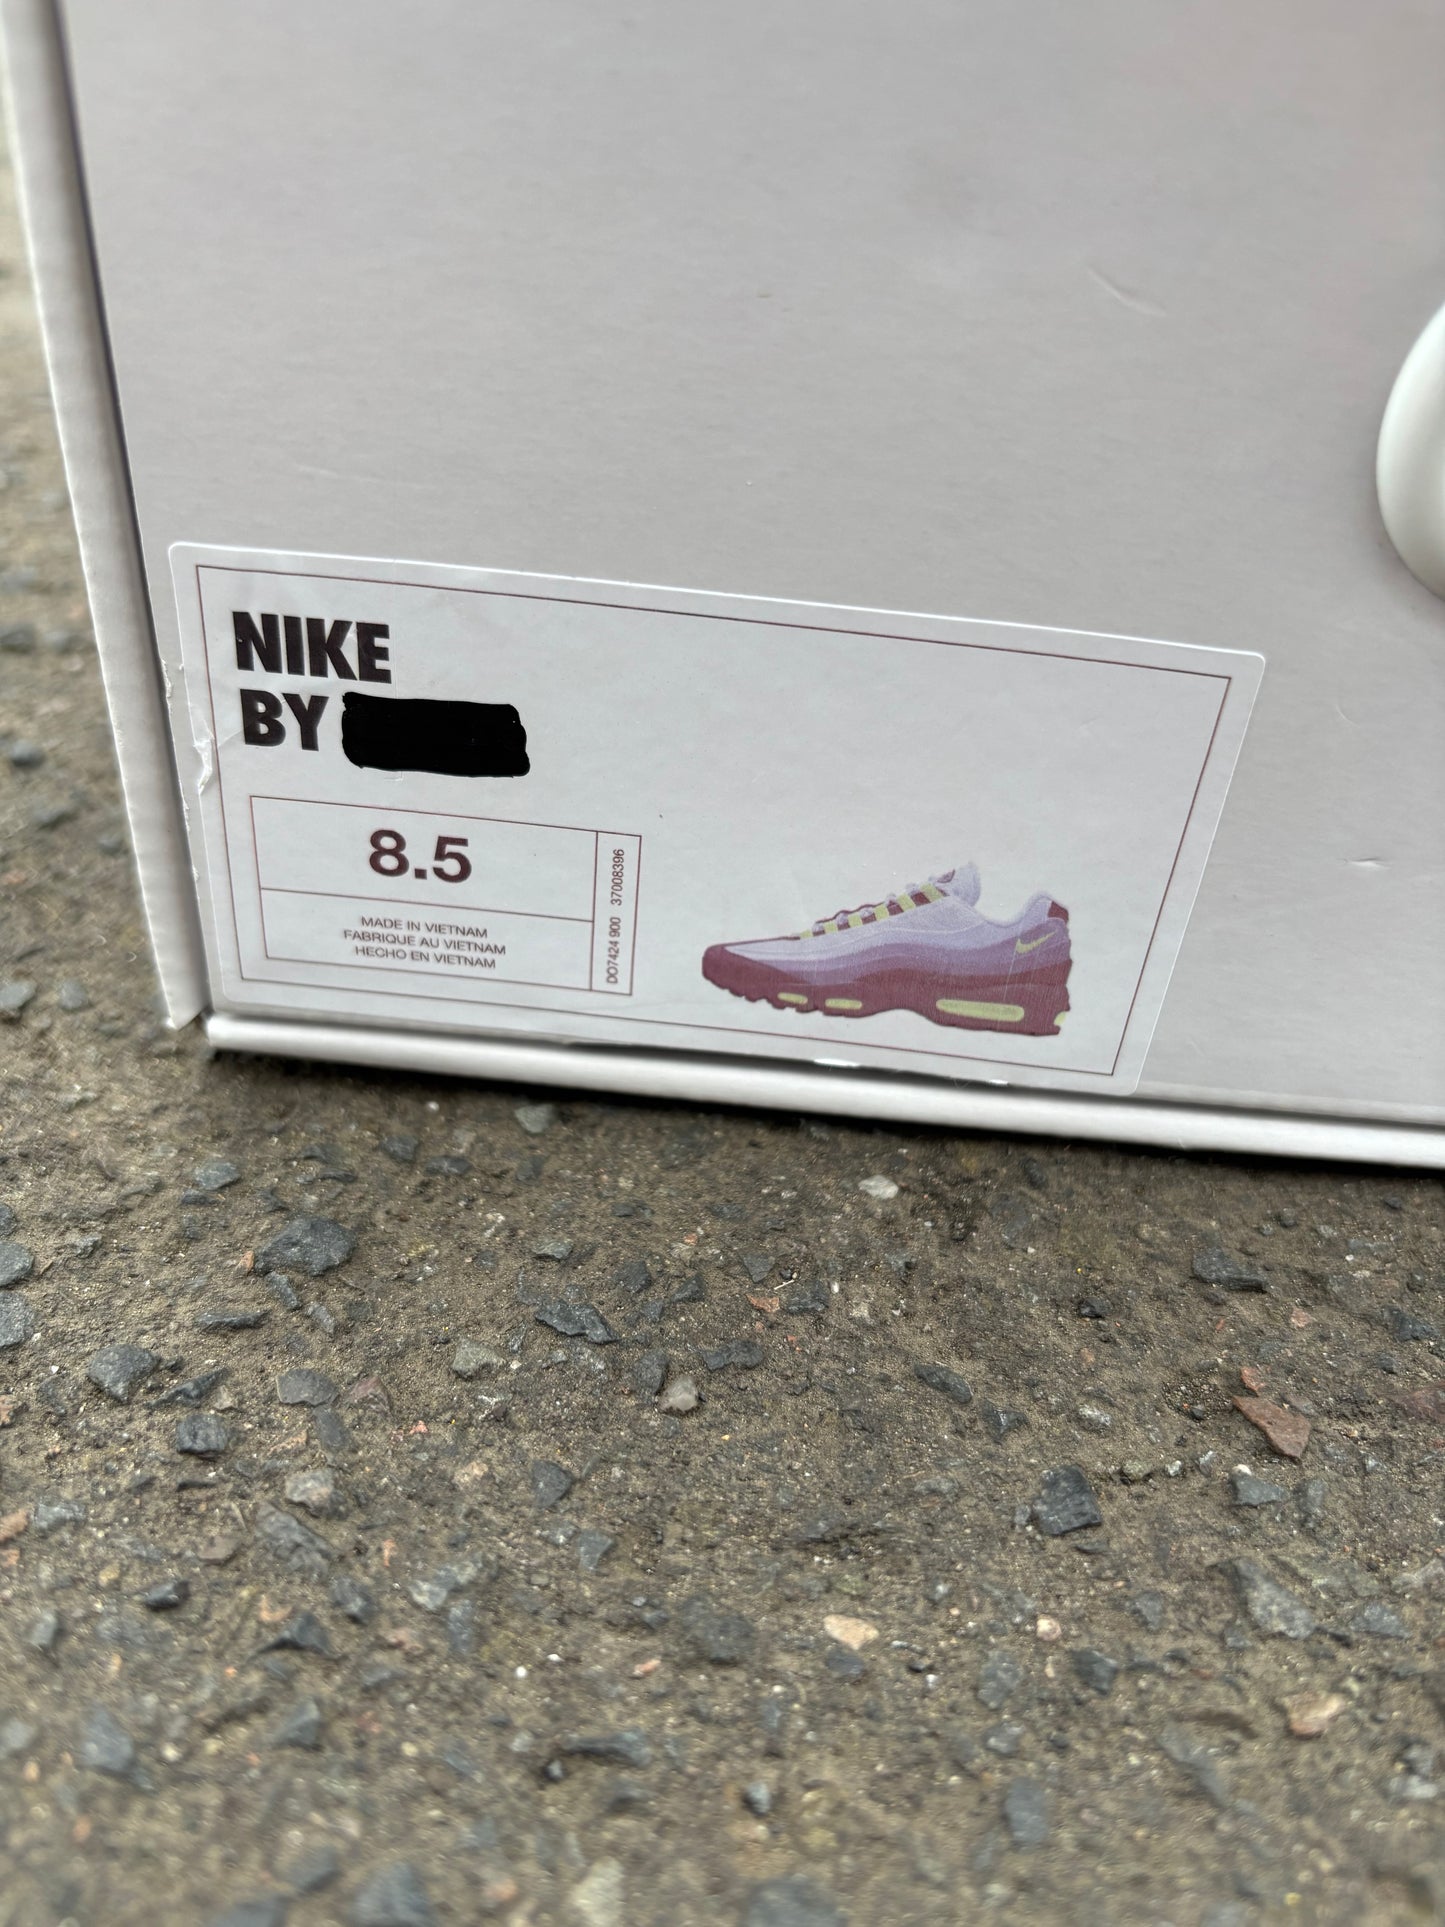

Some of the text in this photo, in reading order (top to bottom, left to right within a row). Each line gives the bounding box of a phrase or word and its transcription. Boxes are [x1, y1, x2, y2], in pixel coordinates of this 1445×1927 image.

[232, 611, 392, 684] NIKE
[240, 688, 329, 751] BY
[369, 829, 472, 883] 8.5
[610, 848, 625, 906] 37008396
[343, 929, 506, 955] FABRIQUE AU VIETNAM
[361, 916, 488, 938] MADE IN VIETNAM
[609, 916, 621, 938] 900
[355, 946, 496, 969] HECHO EN VIETNAM
